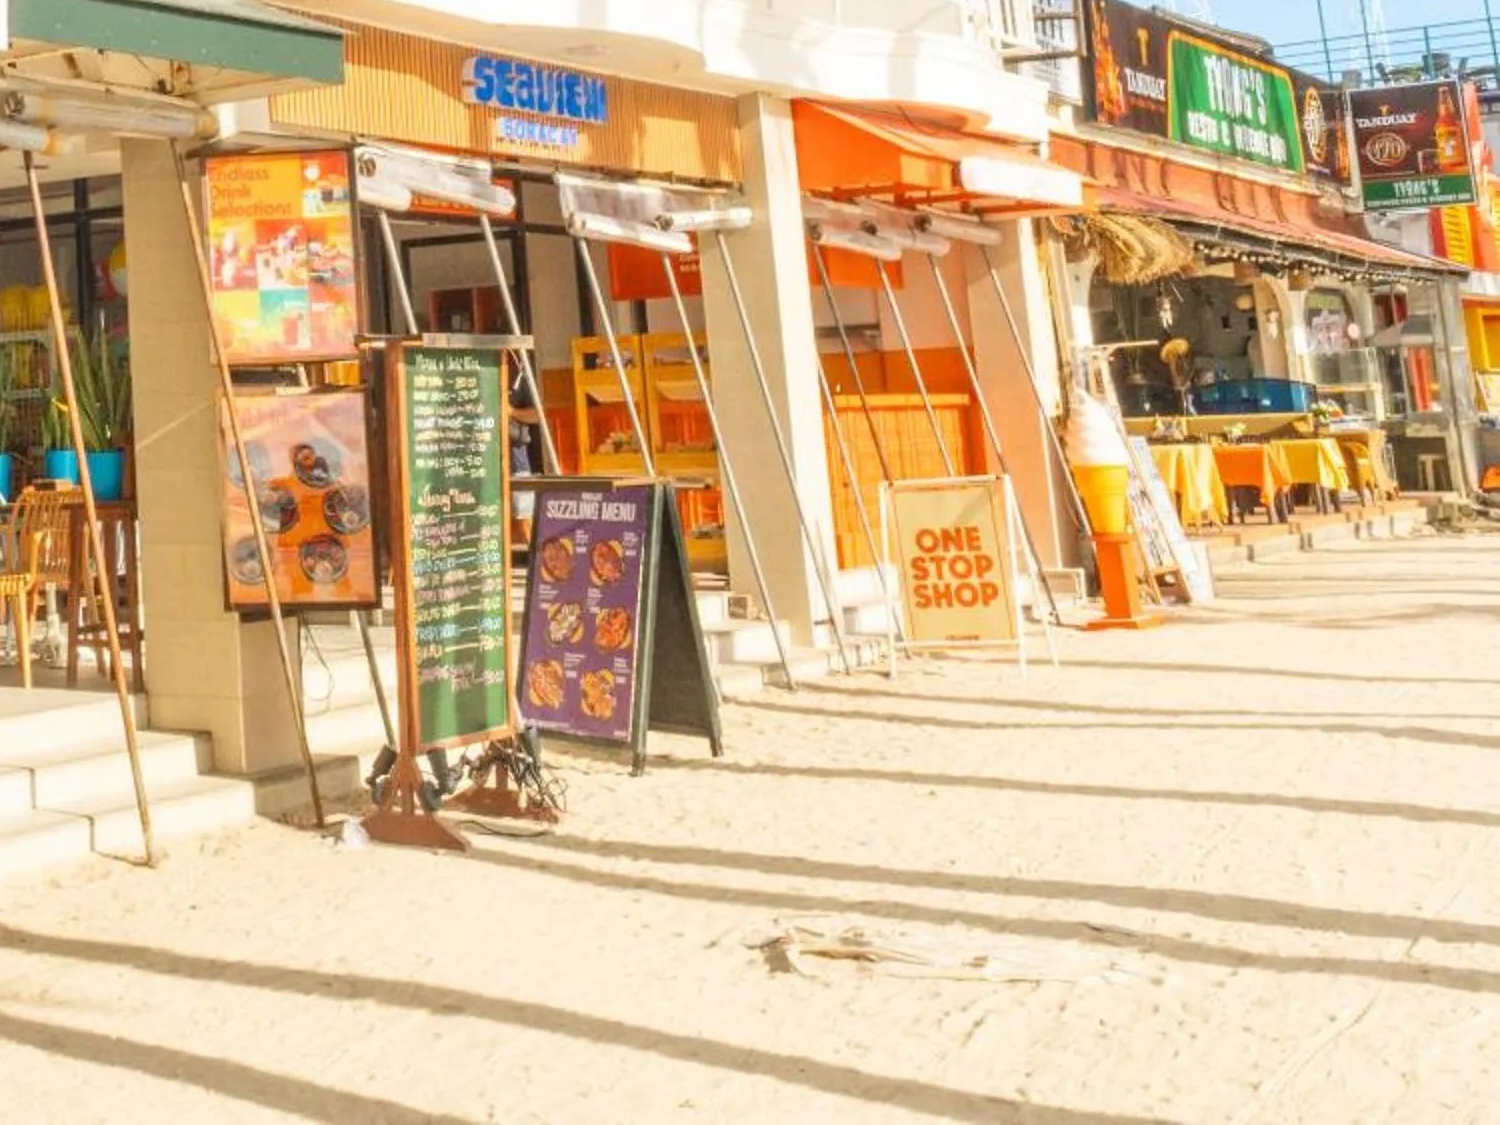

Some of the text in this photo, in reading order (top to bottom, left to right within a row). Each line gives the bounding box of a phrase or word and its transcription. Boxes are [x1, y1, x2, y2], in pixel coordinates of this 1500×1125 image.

[1355, 113, 1416, 128] TANDUAY
[209, 166, 270, 182] Endless
[210, 183, 251, 199] Drink
[211, 198, 293, 218] Selections
[546, 500, 636, 522] SIZZLING MENU
[915, 526, 981, 554] ONE
[910, 555, 993, 581] STOP
[912, 581, 999, 610] SHOP
